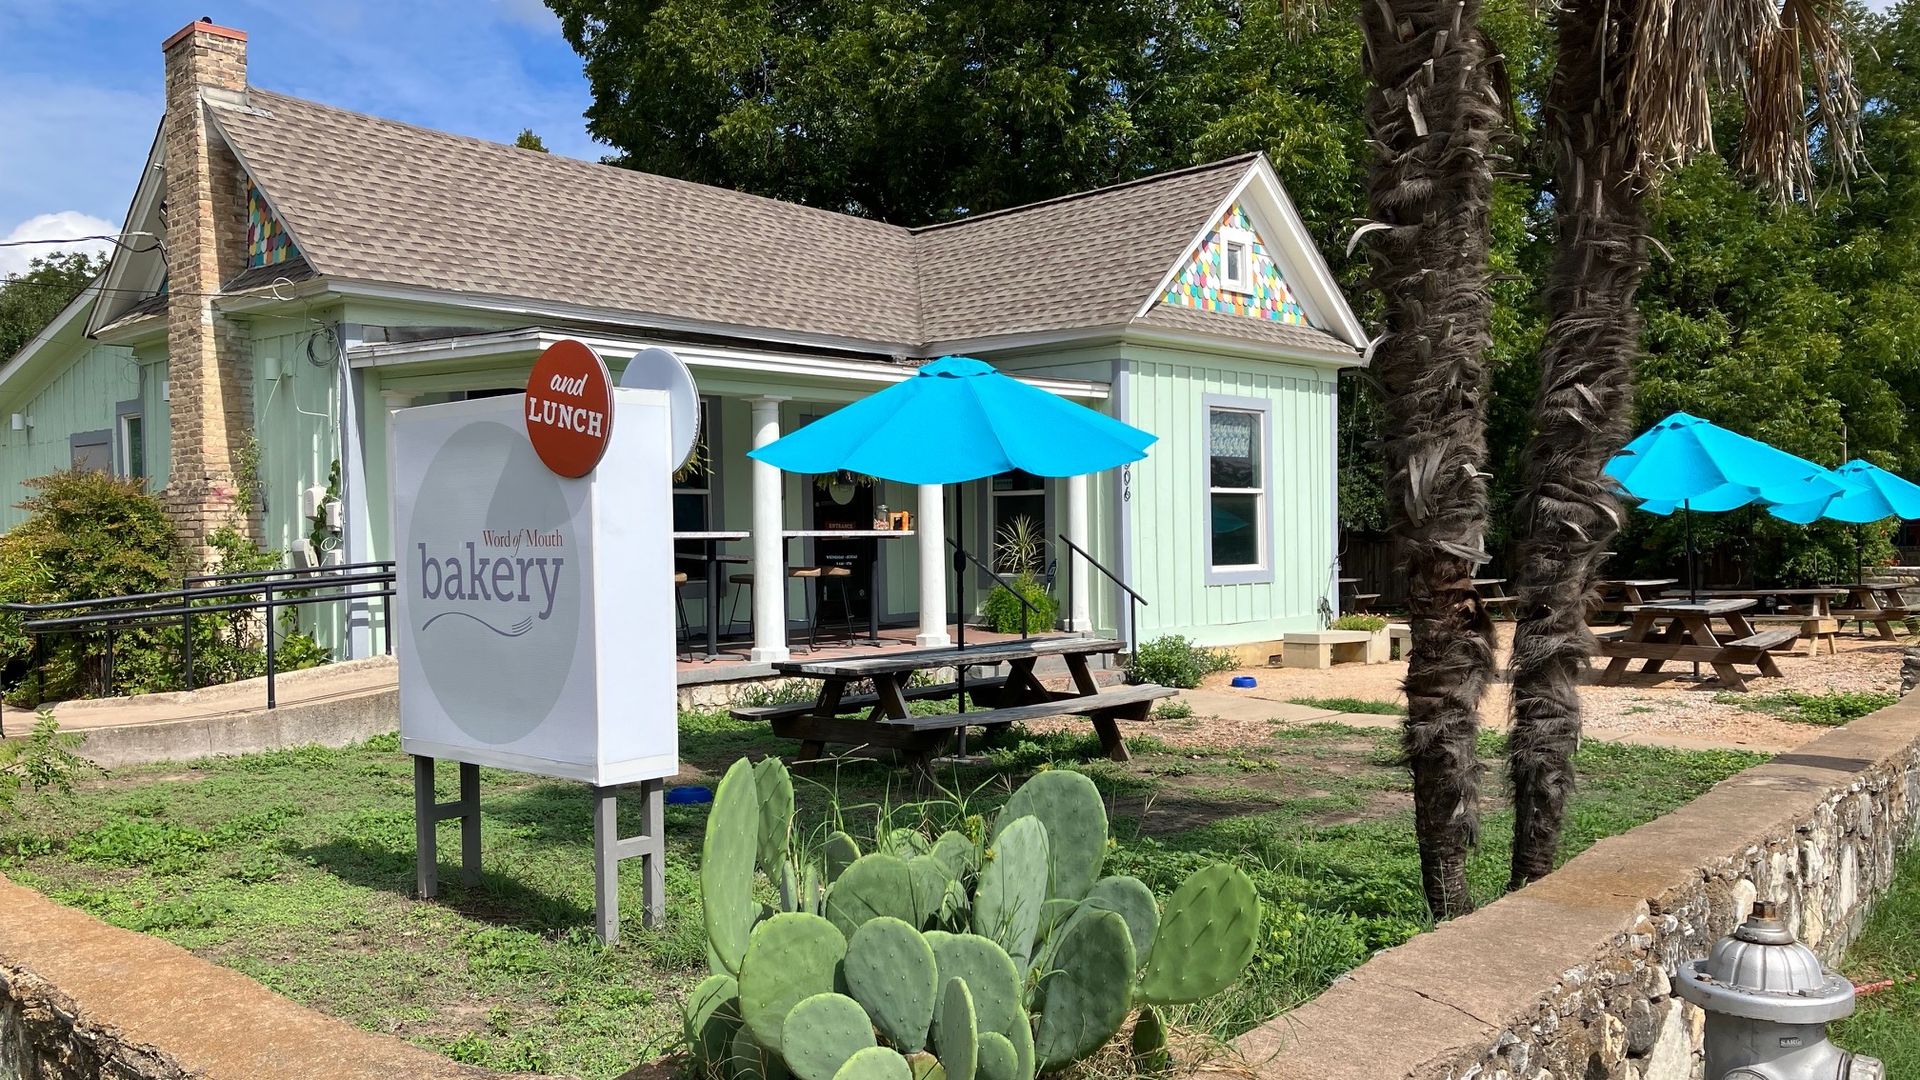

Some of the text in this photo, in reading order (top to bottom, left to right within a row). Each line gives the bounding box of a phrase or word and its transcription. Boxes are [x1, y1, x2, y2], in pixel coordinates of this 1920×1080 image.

[550, 373, 588, 397] and
[528, 397, 603, 438] LUNCH
[482, 528, 563, 558] Word of Mouth
[417, 541, 565, 621] bakery
